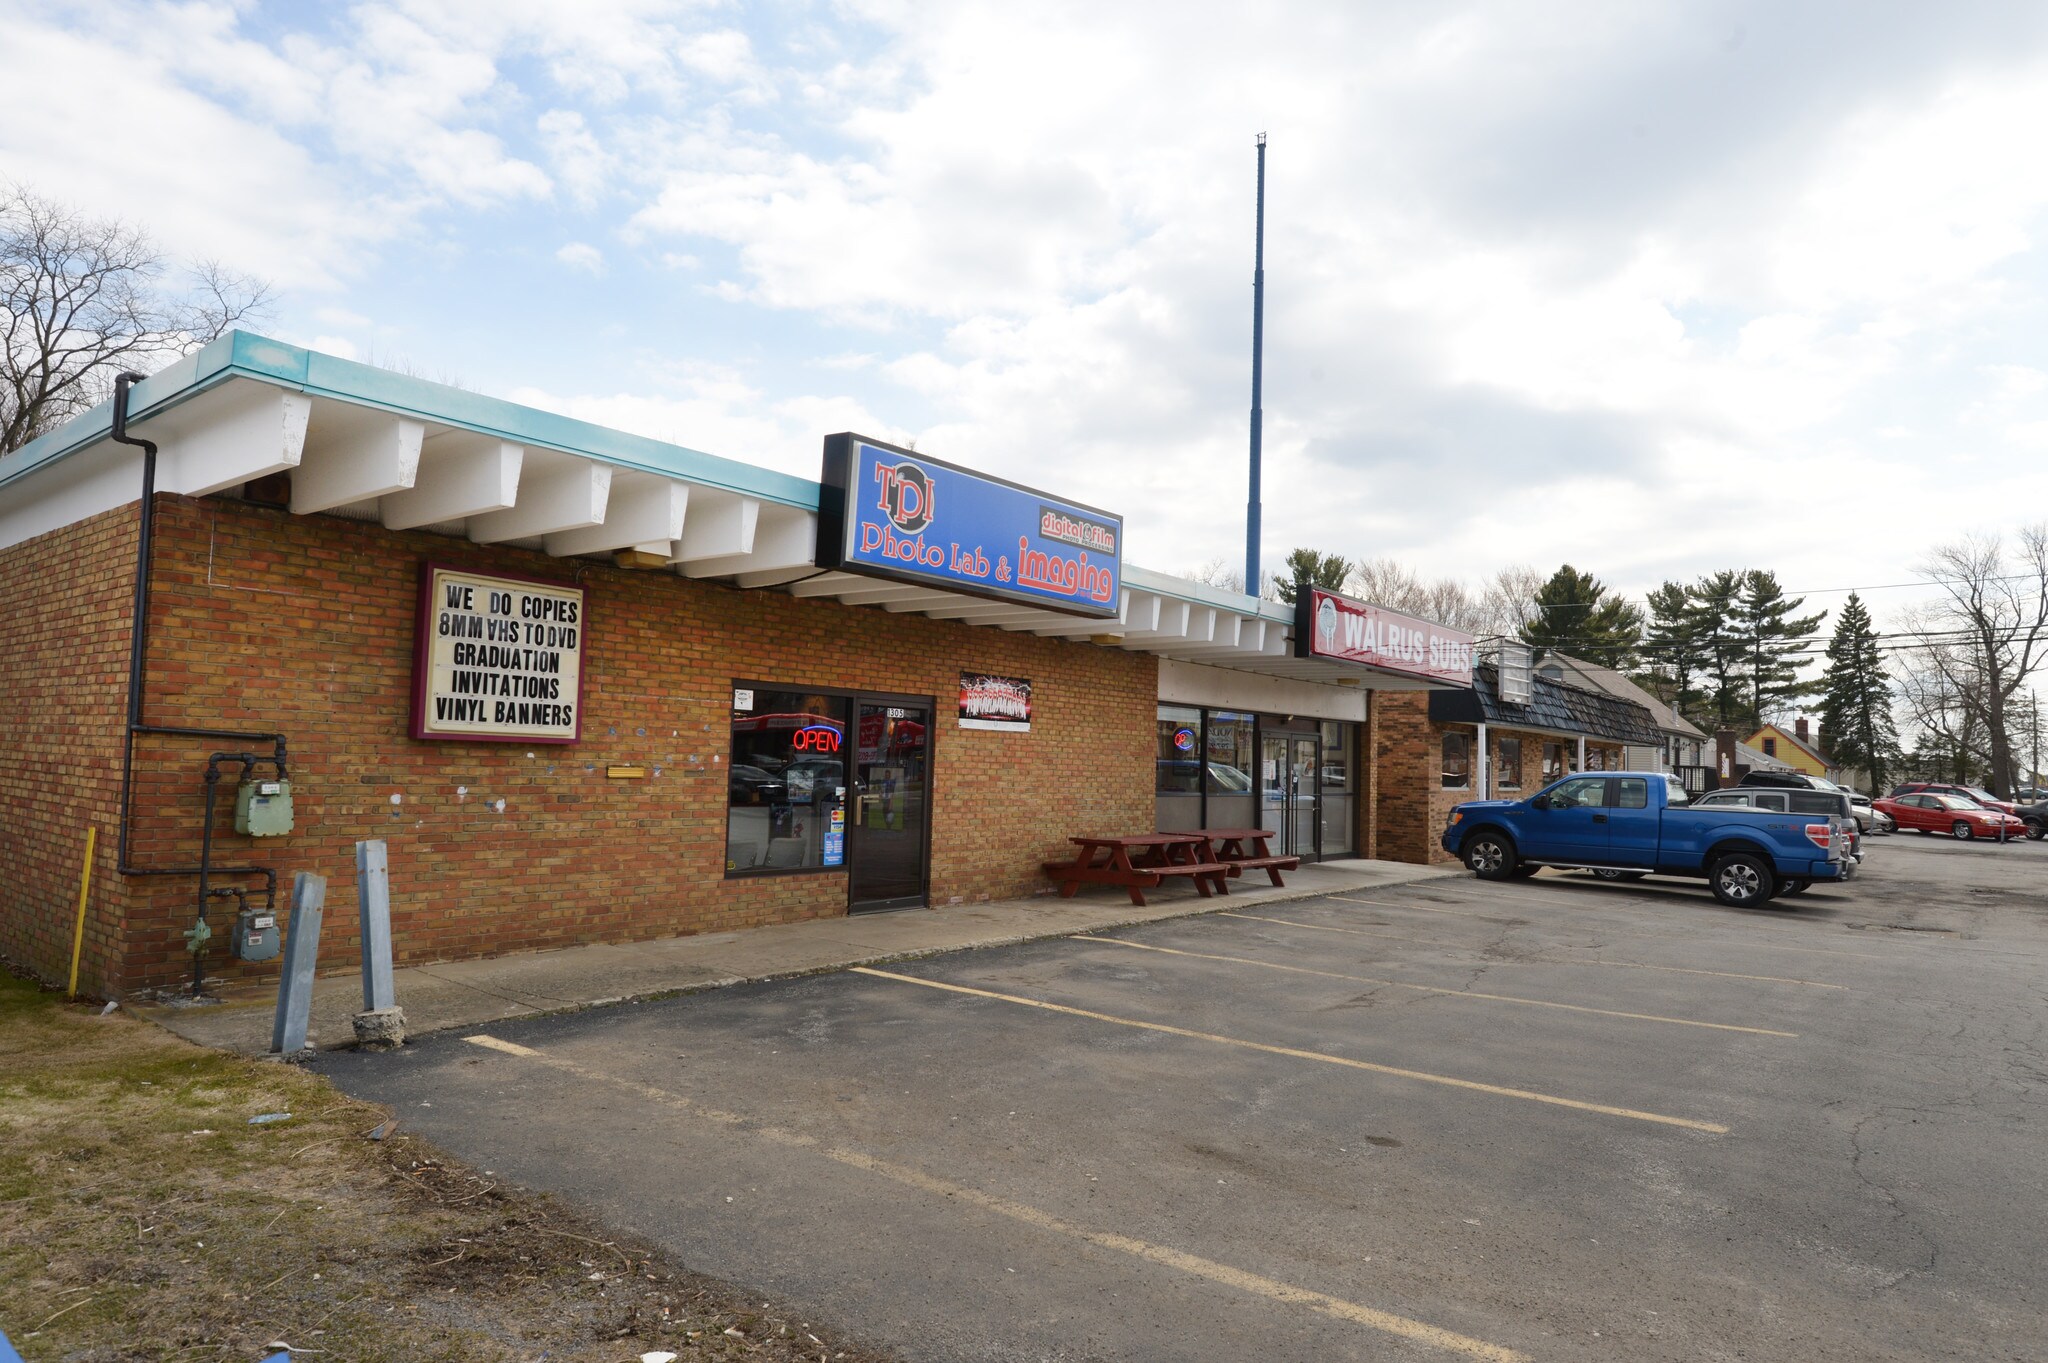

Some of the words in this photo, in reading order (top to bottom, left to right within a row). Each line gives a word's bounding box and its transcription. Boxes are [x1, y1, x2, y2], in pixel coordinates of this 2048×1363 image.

[1041, 512, 1083, 538] digital
[1091, 526, 1115, 548] film
[1062, 534, 1080, 544] PHOTO
[1081, 539, 1114, 553] PROCESSING
[949, 543, 991, 578] Lab
[995, 556, 1012, 583] &
[1017, 535, 1113, 603] imaging
[447, 584, 473, 610] WE
[490, 592, 512, 616] DO
[521, 596, 578, 623] COPIES
[439, 612, 483, 639] 8MM
[524, 623, 545, 646] TO
[547, 626, 577, 650] DVD
[1344, 612, 1425, 664] WALRUS
[1428, 635, 1470, 674] SUBS
[454, 642, 560, 674] GRADUATION
[452, 670, 560, 700] INVITATIONS
[436, 697, 487, 722] VINYL
[494, 701, 572, 726] BANNERS
[793, 730, 839, 752] OPEN
